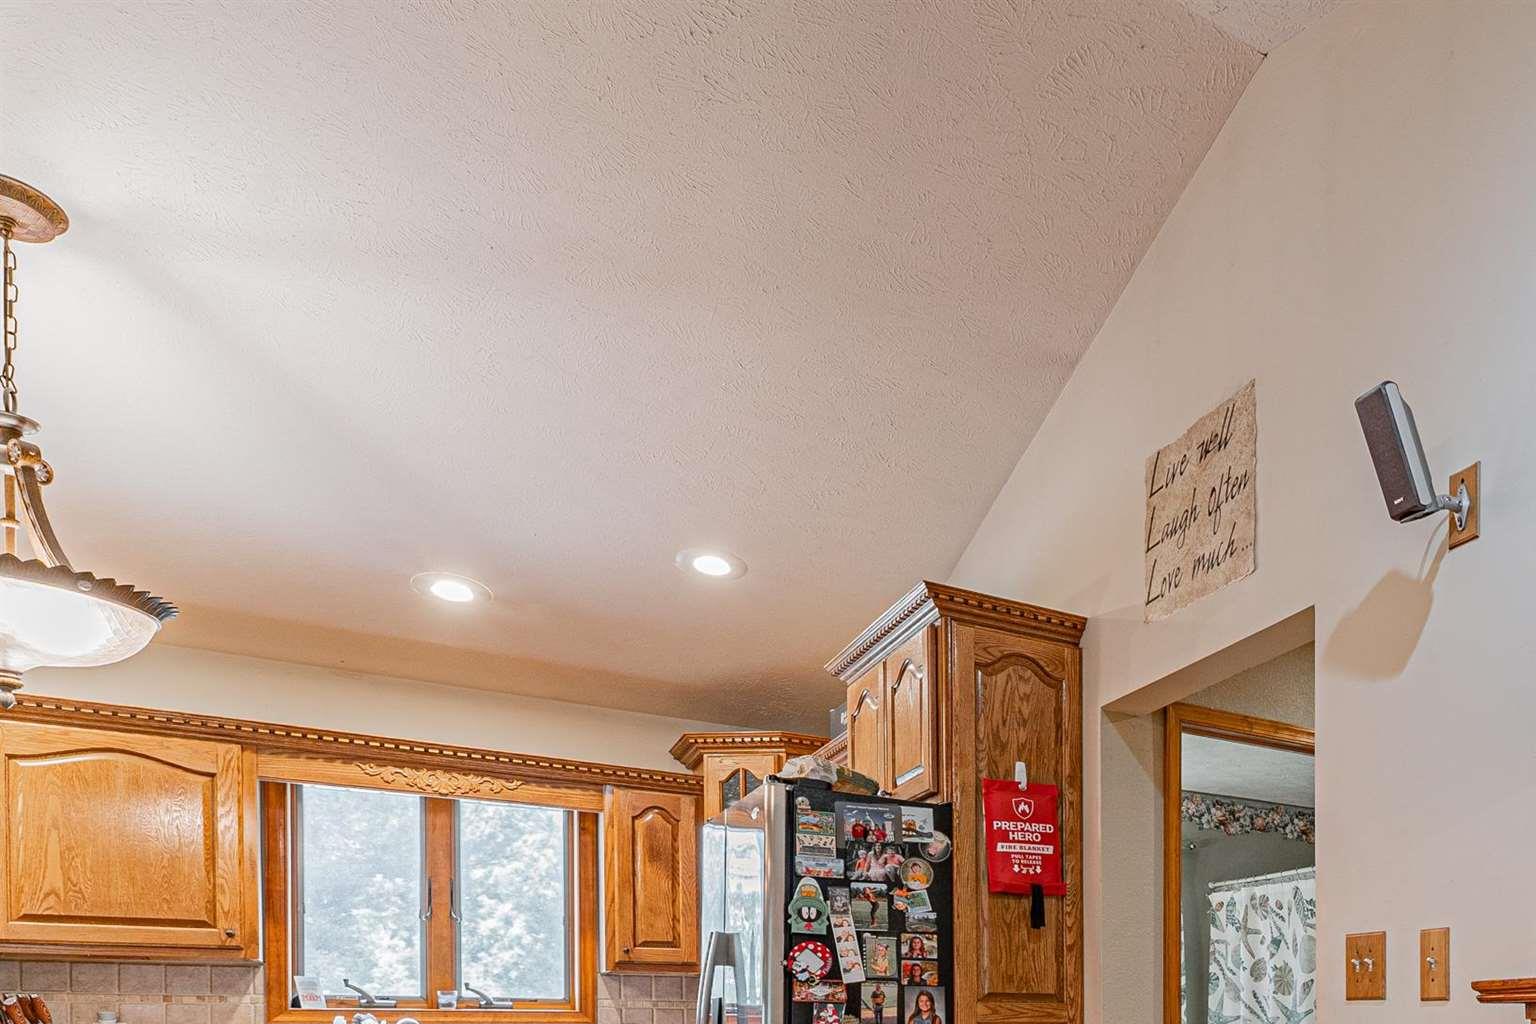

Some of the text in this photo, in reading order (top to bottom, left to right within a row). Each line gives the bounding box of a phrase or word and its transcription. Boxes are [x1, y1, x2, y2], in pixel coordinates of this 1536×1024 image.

[1148, 402, 1236, 499] Live well
[1145, 486, 1200, 554] Laugh
[1145, 558, 1184, 607] Love
[993, 821, 1054, 833] PREPARED
[1009, 832, 1041, 841] HERO
